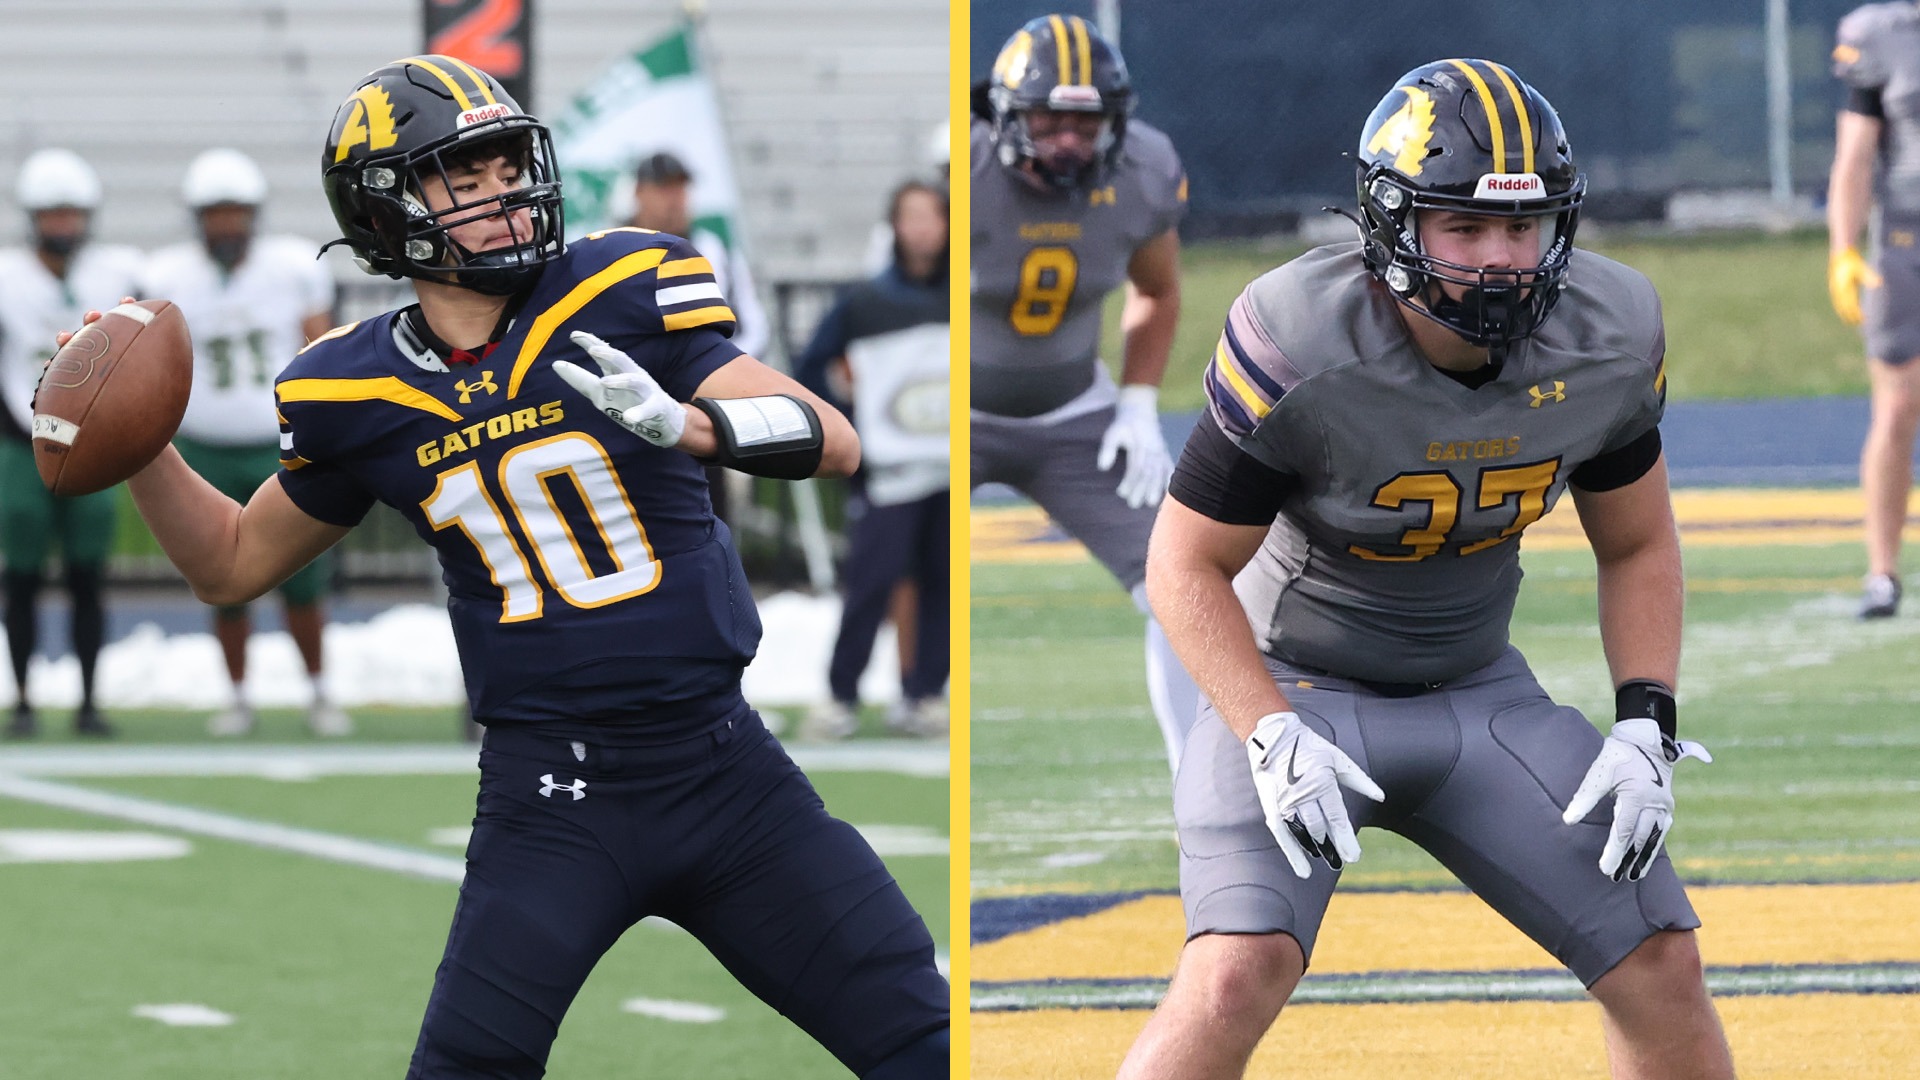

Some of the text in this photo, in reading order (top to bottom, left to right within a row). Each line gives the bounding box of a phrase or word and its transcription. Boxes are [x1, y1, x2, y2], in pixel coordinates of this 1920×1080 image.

[427, 0, 524, 78] 2
[463, 105, 509, 125] Riddell
[1487, 178, 1538, 192] Riddell
[1010, 245, 1079, 336] 8
[416, 400, 564, 467] GATORS
[1426, 435, 1521, 462] GATORS
[419, 431, 663, 623] 10
[1348, 454, 1563, 563] 37
